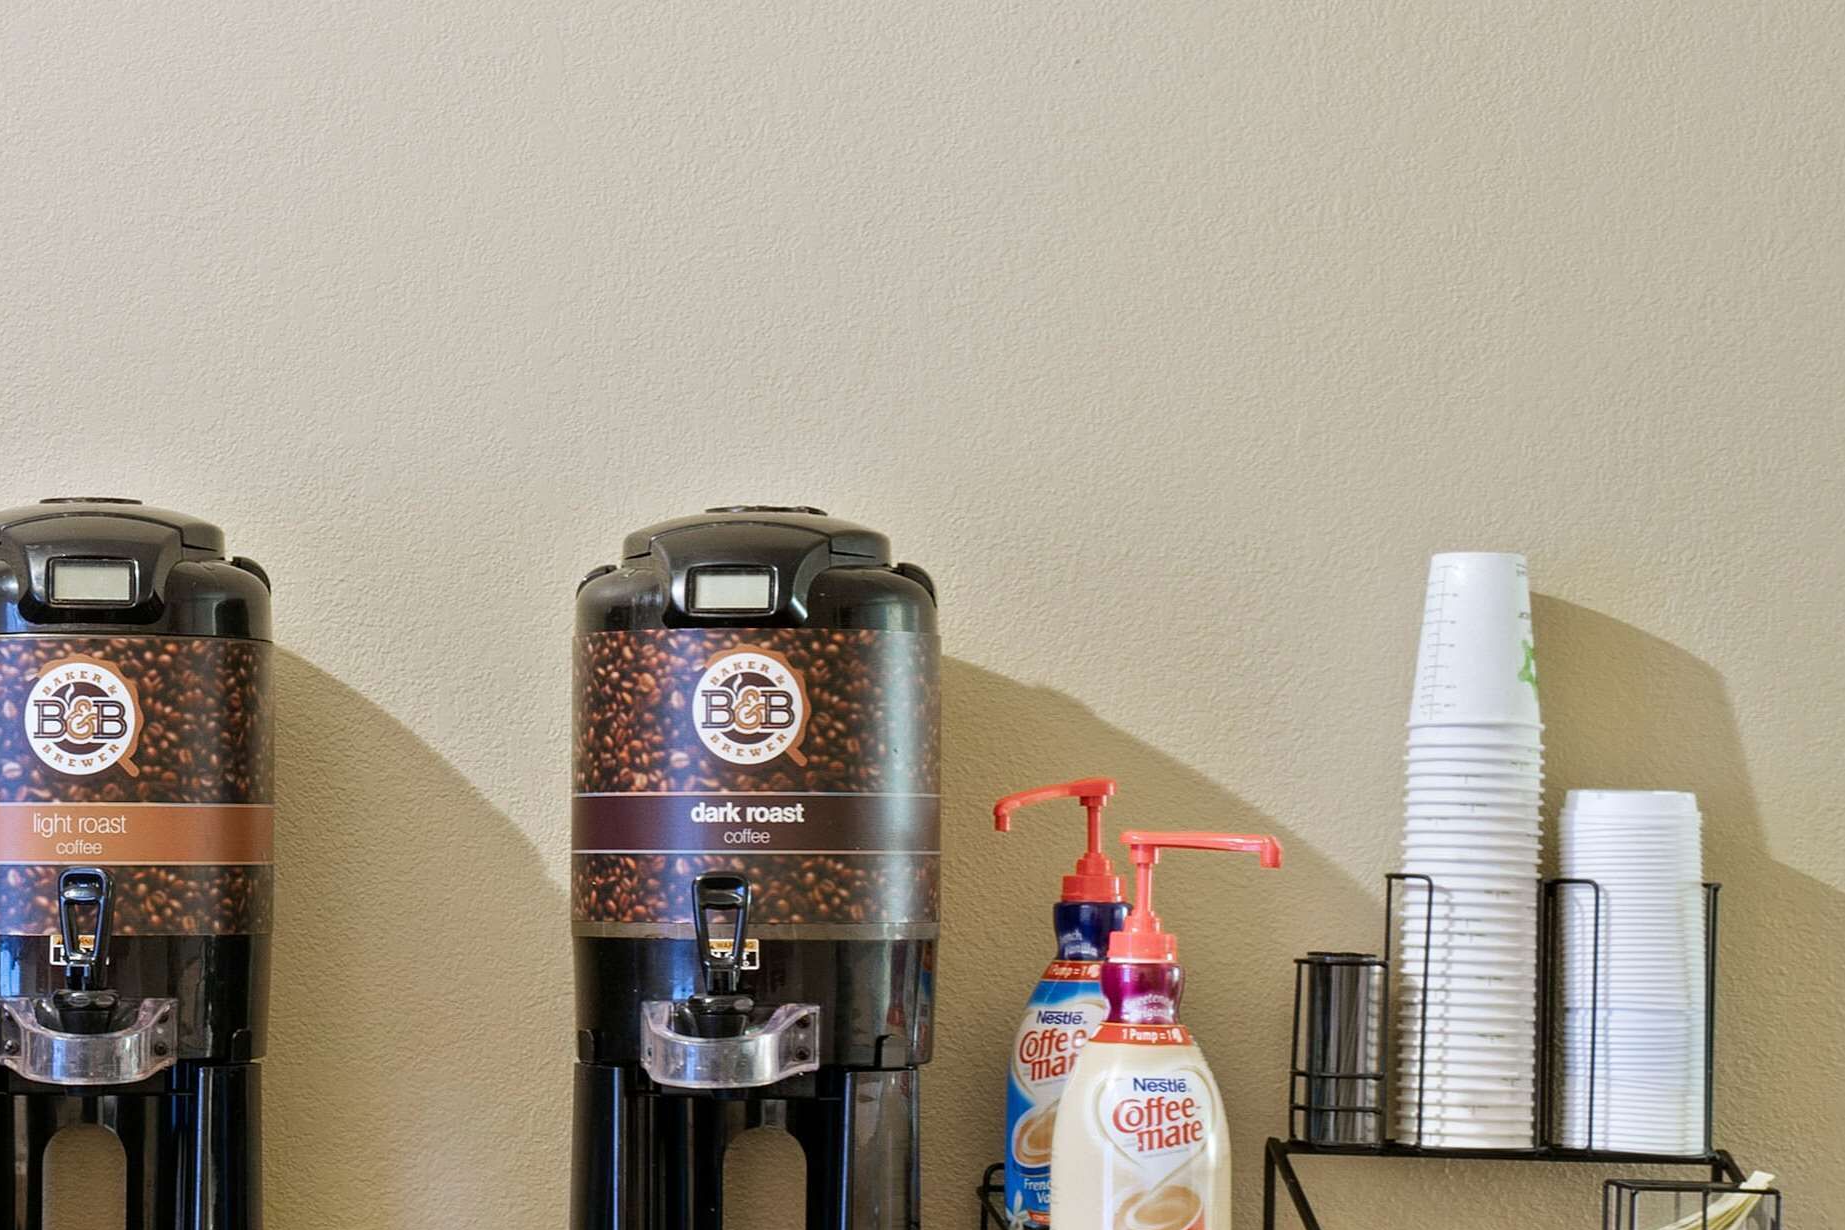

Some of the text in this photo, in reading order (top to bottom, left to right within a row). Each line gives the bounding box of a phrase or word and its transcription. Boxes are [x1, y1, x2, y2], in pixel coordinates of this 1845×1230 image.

[42, 671, 103, 695] BAKER
[710, 661, 770, 685] BAKER
[33, 699, 127, 740] B&B
[701, 688, 795, 731] B&B
[42, 744, 120, 768] BREWER
[710, 734, 788, 757] BREWER
[691, 802, 805, 823] dark roast
[33, 813, 126, 838] light roast
[723, 829, 771, 844] coffee
[56, 839, 103, 855] coffee
[1036, 1010, 1083, 1025] Nestlé
[1129, 1029, 1157, 1042] Pump
[1133, 1077, 1187, 1093] Nestlé
[1137, 1120, 1203, 1152] mate
